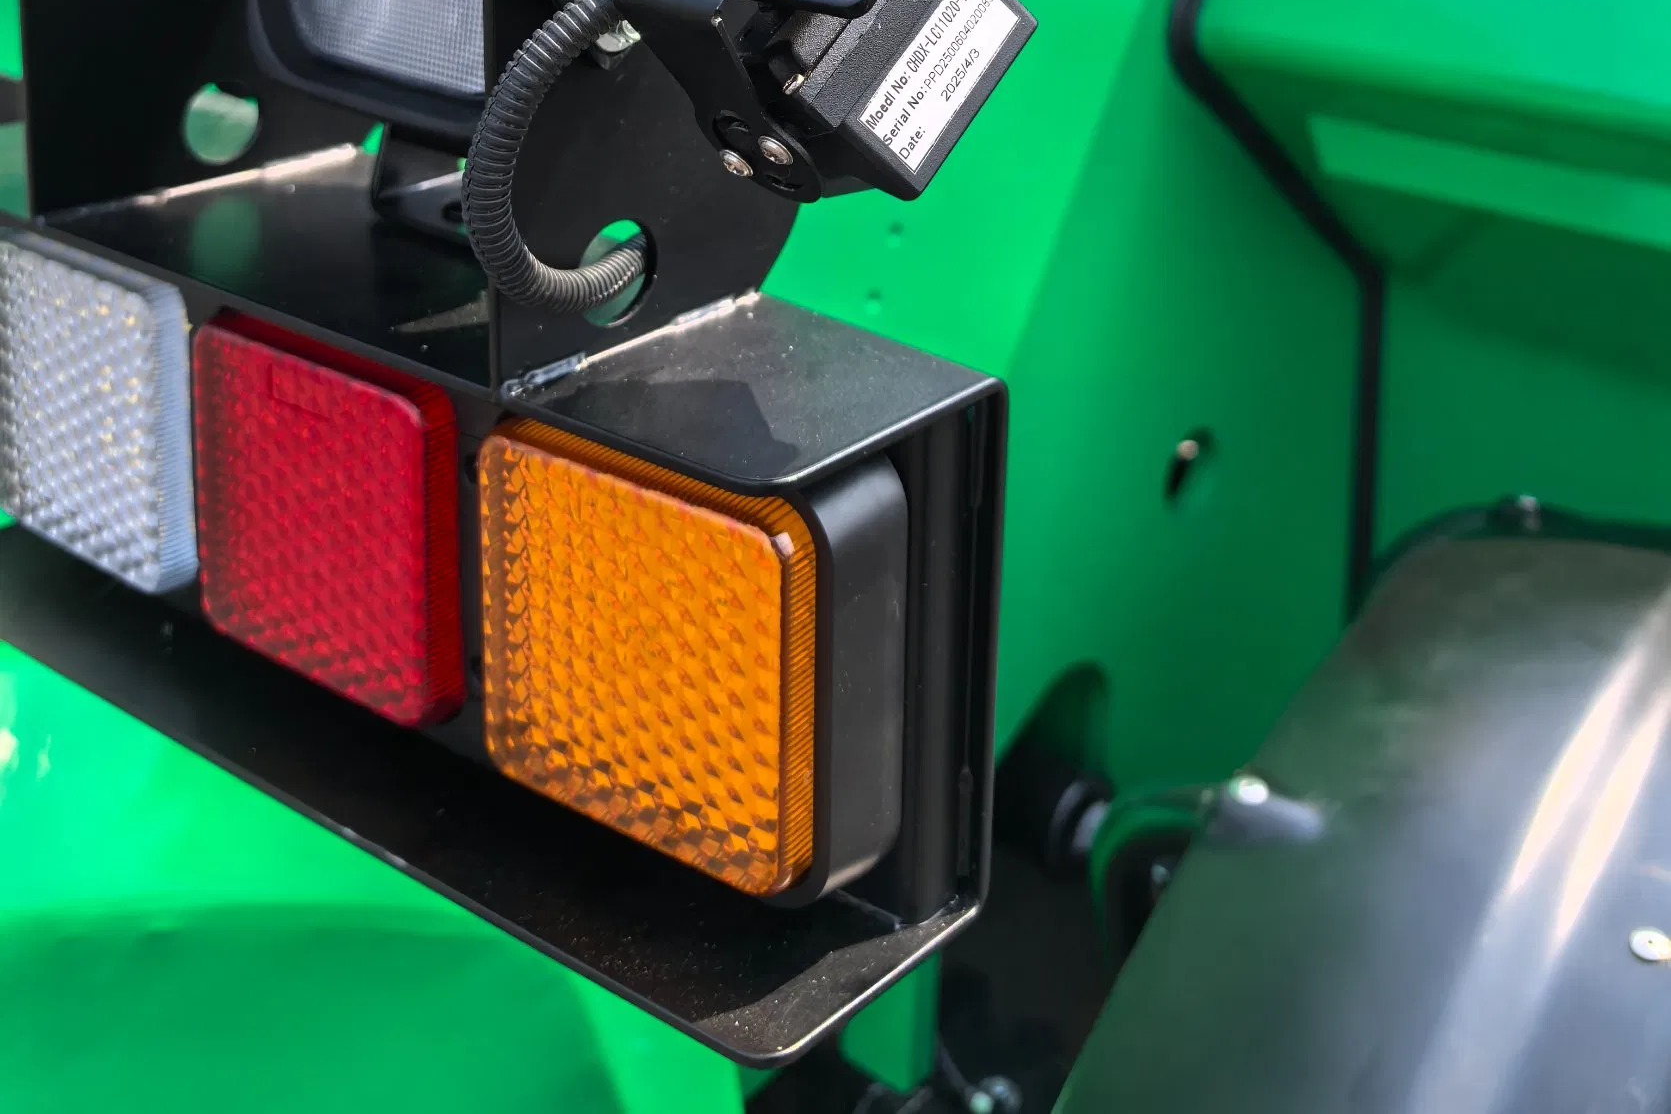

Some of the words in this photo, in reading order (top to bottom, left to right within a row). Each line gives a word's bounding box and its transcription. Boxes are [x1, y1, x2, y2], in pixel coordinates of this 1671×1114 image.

[865, 91, 895, 130] Moedl
[891, 72, 911, 98] No:
[882, 108, 910, 146] Serial
[907, 86, 928, 110] No:
[899, 126, 926, 160] Date:
[940, 48, 980, 102] 2025/4/3
